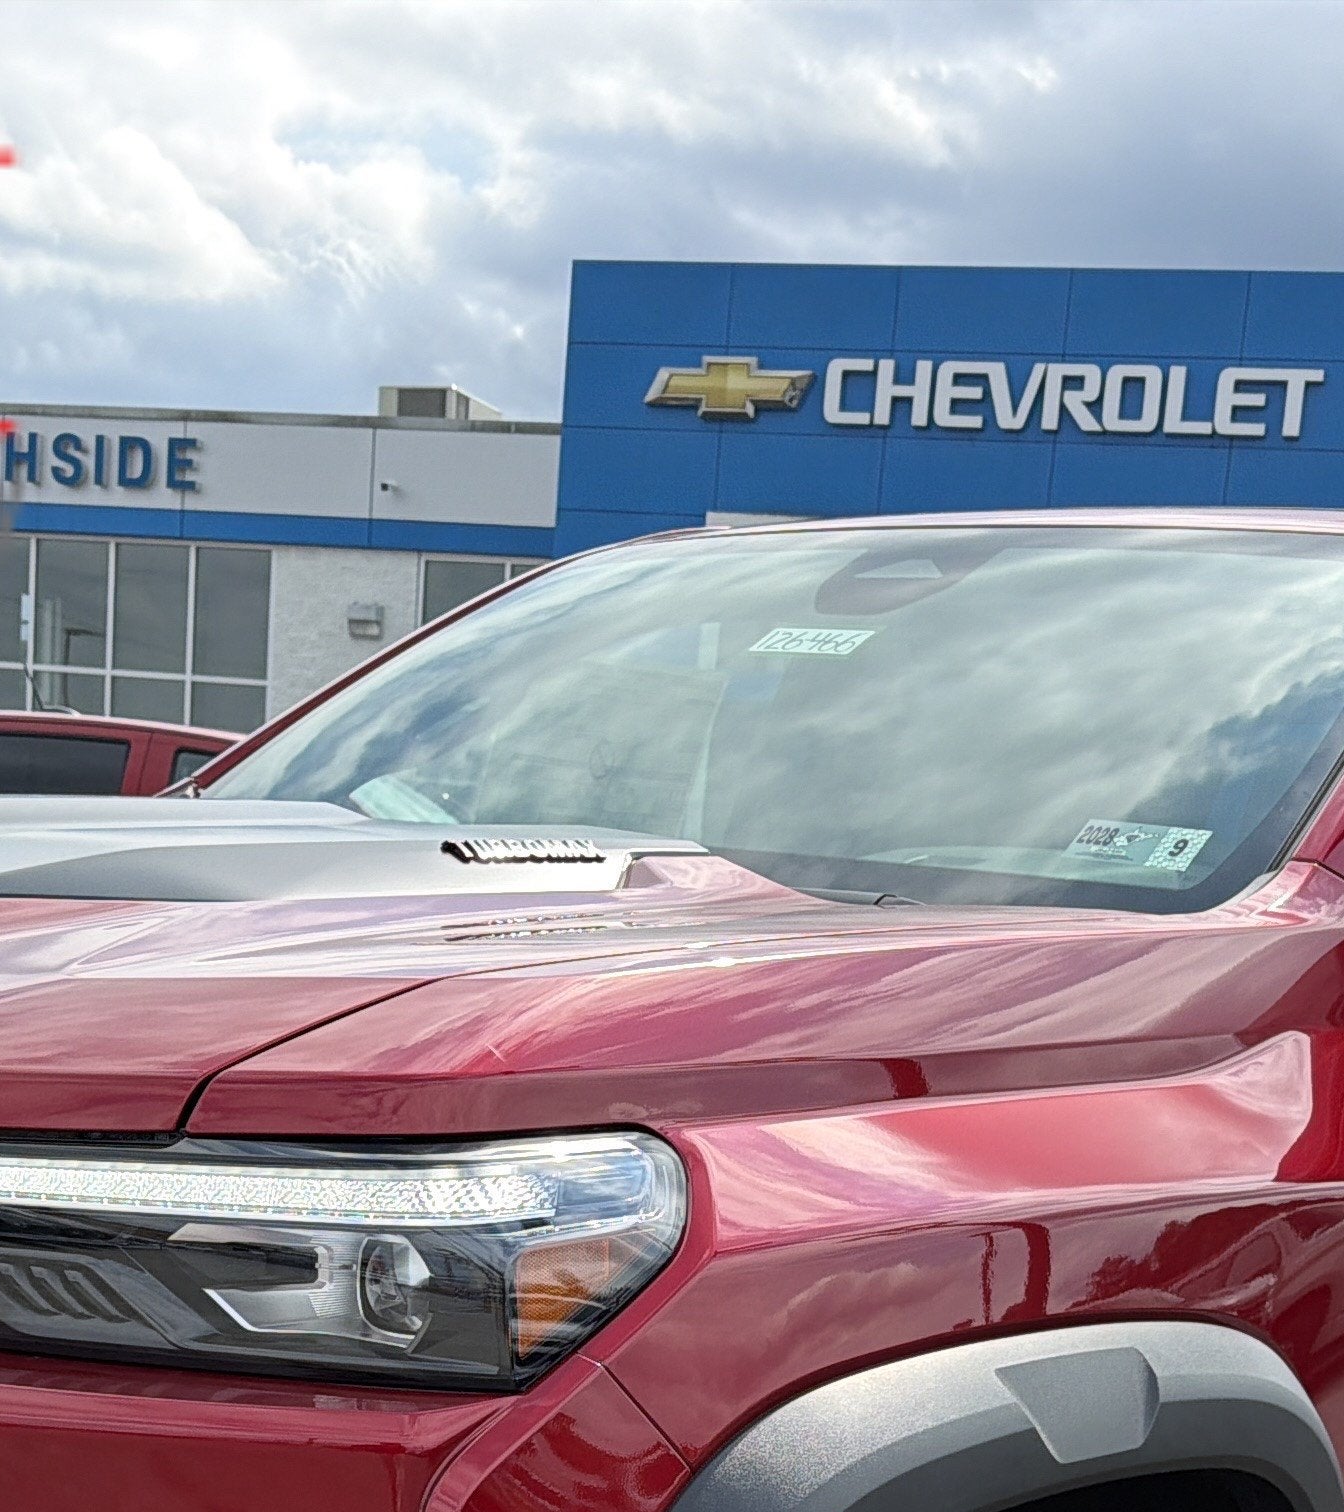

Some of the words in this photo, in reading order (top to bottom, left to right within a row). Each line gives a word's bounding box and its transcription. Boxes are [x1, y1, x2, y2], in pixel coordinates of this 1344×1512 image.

[823, 357, 1325, 438] CHEVROLET
[1076, 824, 1120, 847] 2028
[1167, 838, 1190, 858] 9
